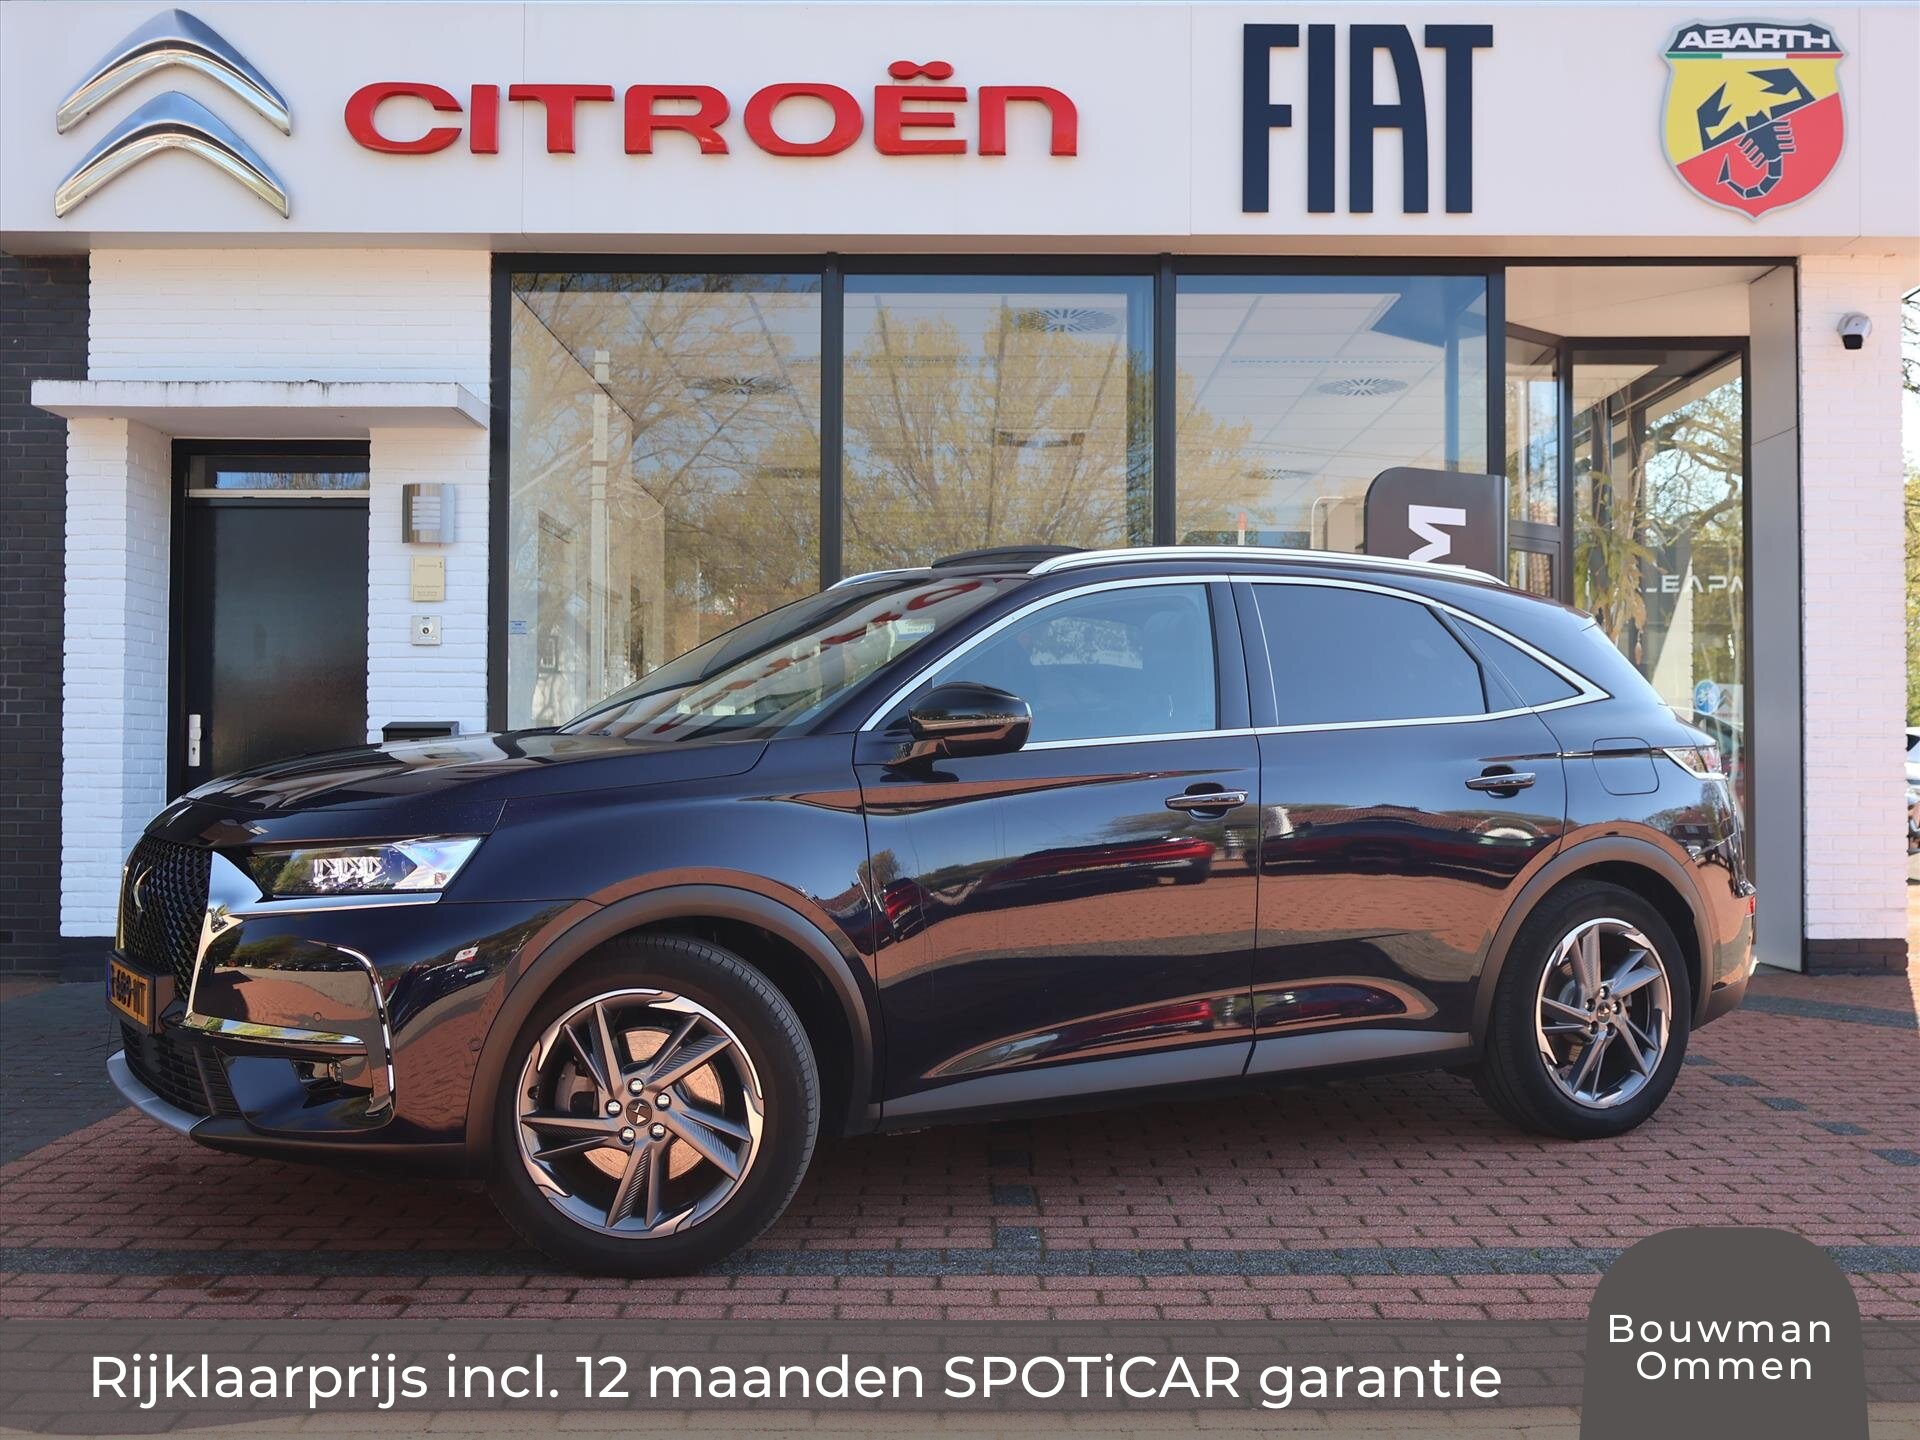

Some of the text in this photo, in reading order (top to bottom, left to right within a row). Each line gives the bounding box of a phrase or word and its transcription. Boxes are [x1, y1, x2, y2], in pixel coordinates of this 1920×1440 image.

[1678, 27, 1831, 49] ABARTH
[346, 61, 1079, 157] CITROËN
[1243, 24, 1493, 213] FIAT
